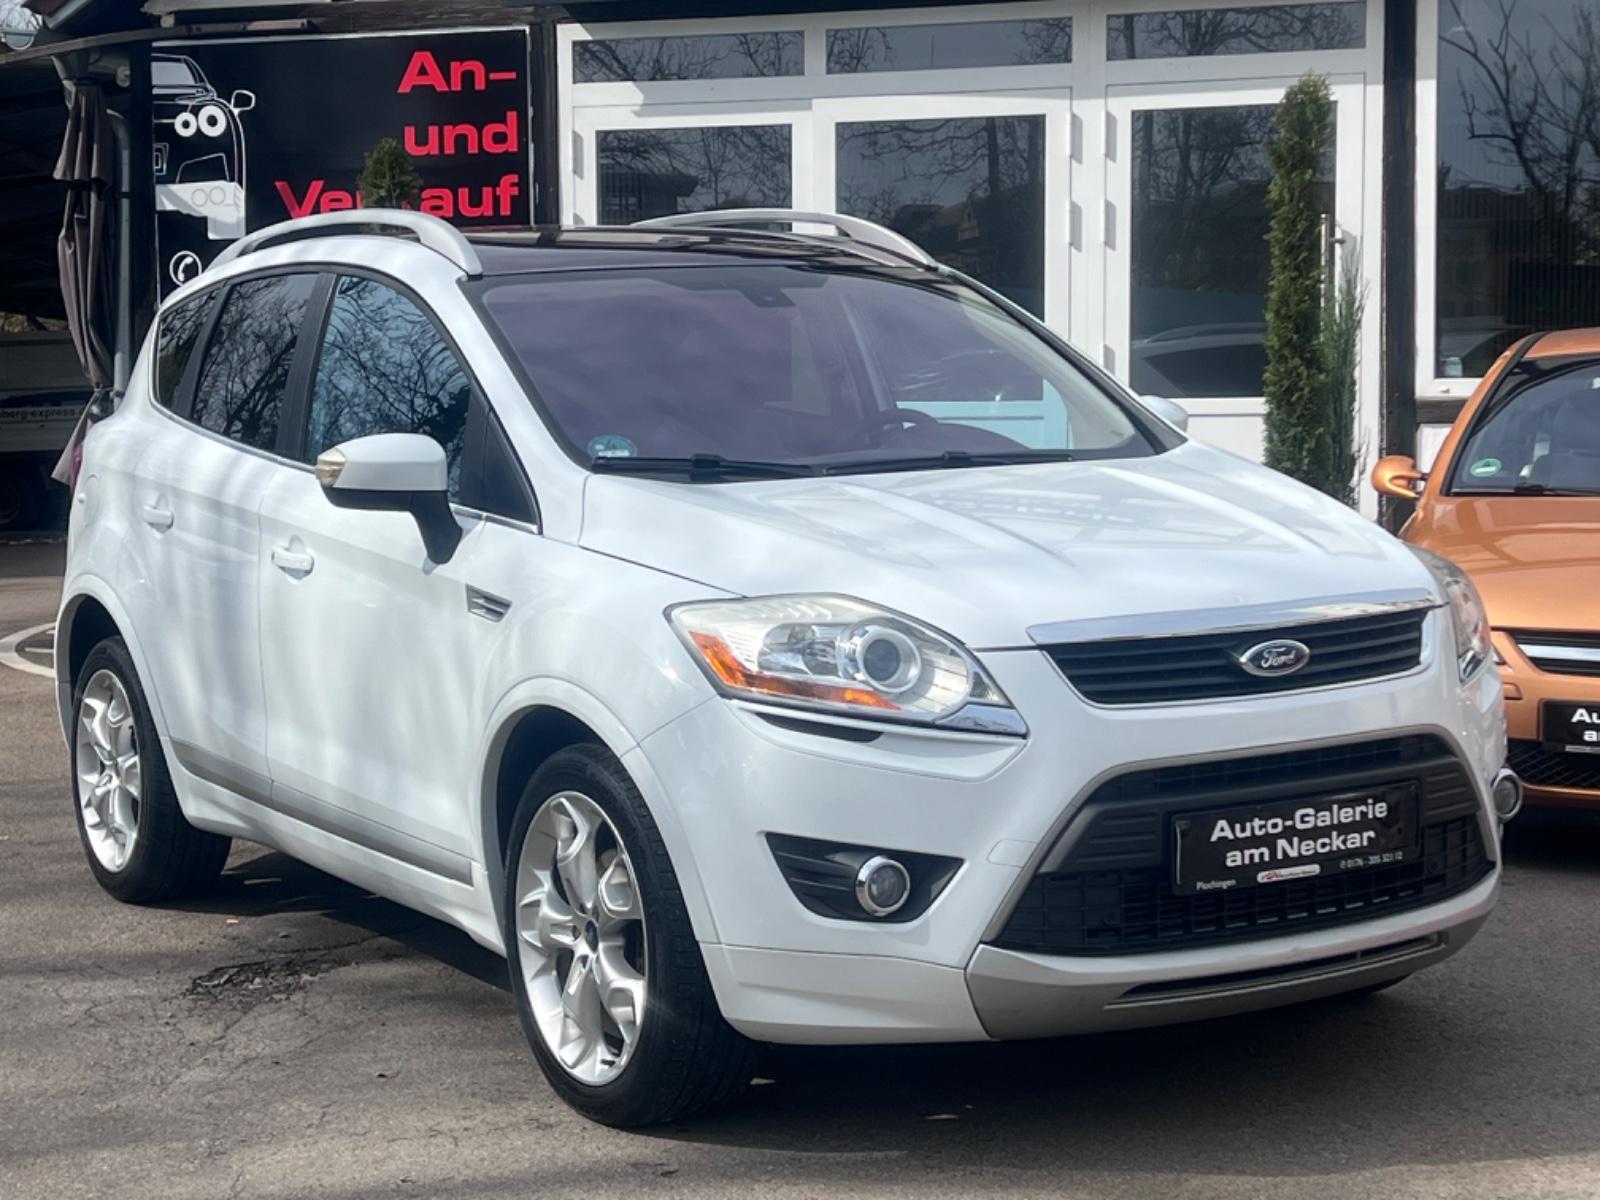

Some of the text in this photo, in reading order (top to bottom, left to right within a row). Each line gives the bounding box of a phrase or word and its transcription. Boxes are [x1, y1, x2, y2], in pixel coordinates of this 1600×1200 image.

[397, 51, 517, 93] An-
[404, 111, 518, 155] und
[274, 174, 519, 219] Veauf
[1261, 647, 1296, 668] Ford
[1210, 799, 1388, 842] Auto-Galerie
[1225, 829, 1376, 867] am Neckar
